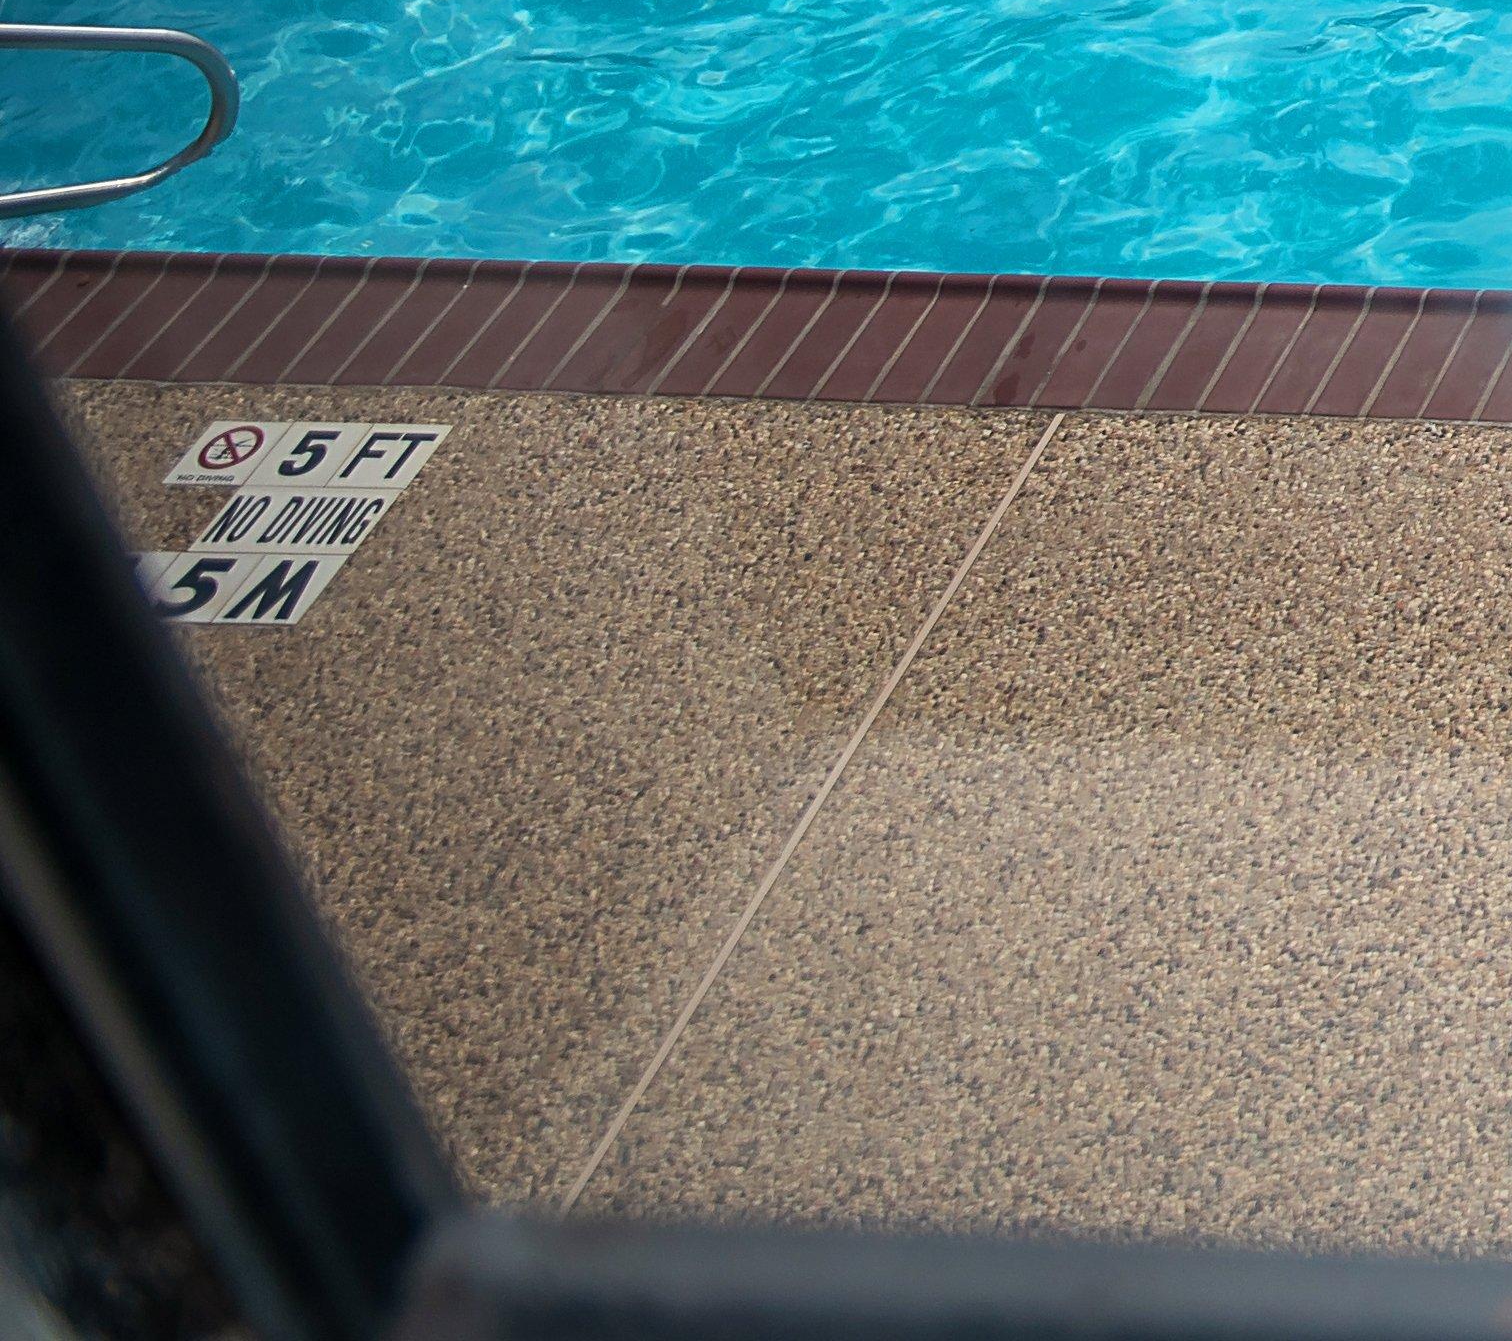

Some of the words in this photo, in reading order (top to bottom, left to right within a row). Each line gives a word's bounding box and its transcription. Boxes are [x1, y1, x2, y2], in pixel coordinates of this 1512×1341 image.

[277, 430, 342, 476] 5
[339, 432, 440, 479] FT
[202, 495, 272, 543] NO
[257, 495, 385, 545] DIVING
[224, 559, 320, 620] M
